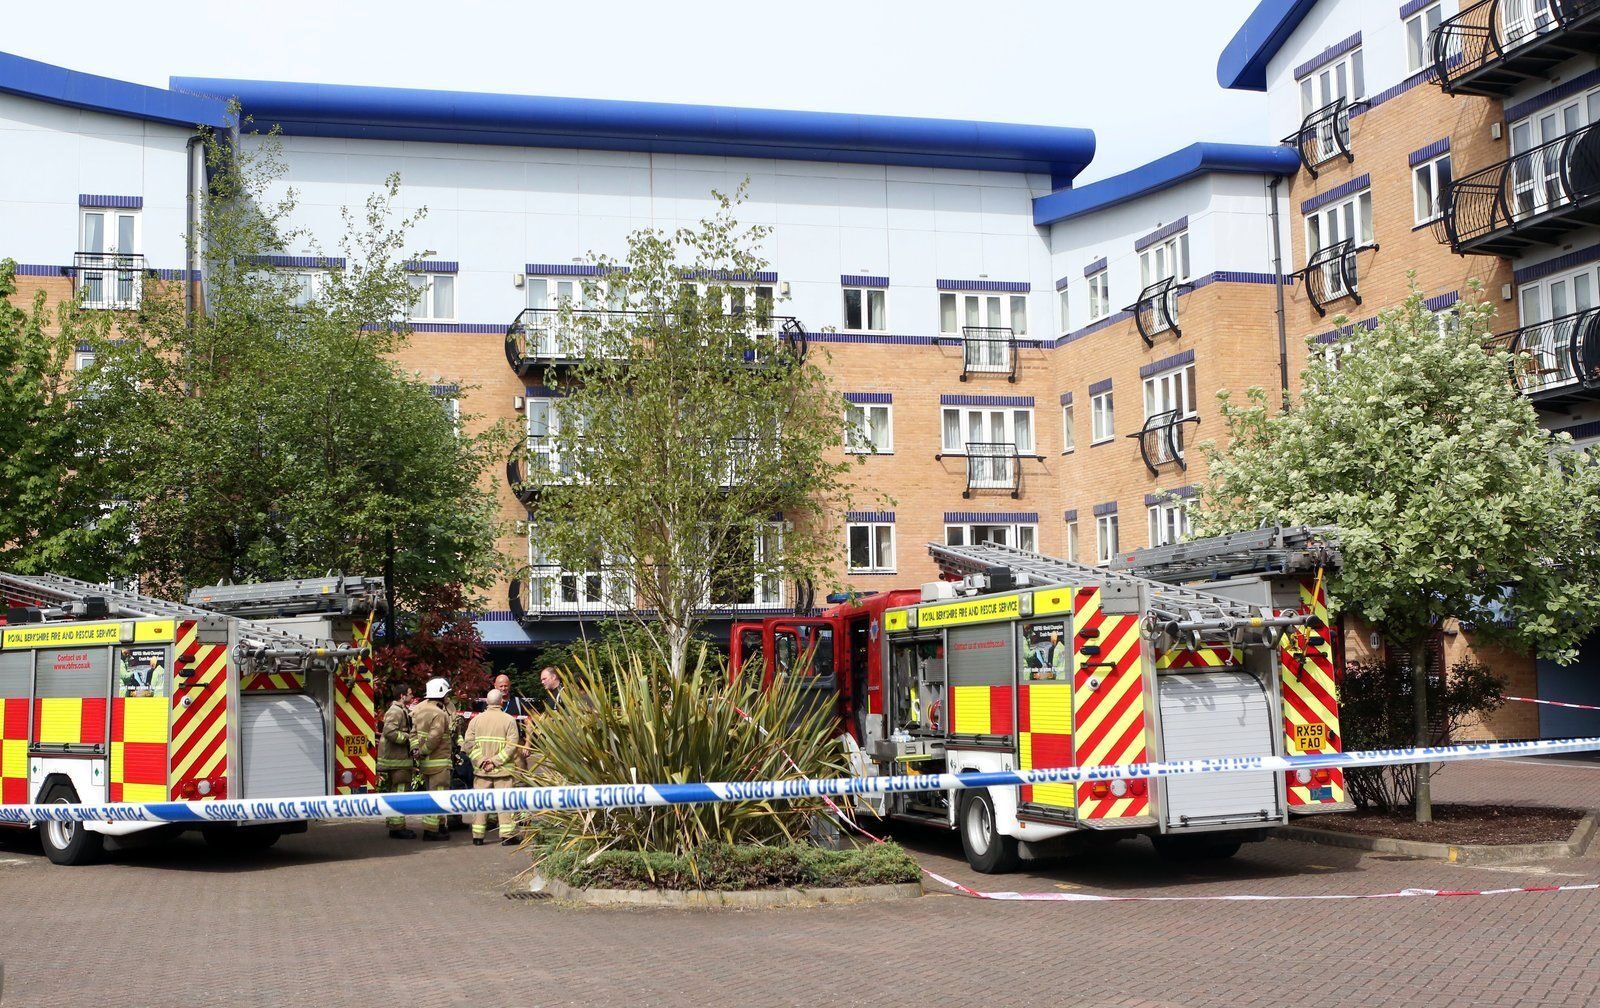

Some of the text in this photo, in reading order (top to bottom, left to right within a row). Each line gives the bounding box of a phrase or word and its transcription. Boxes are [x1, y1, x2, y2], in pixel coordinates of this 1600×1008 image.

[922, 601, 1017, 621] ROYAL BERKSHIRE FIRE AND RESCUE SERVICE
[8, 628, 117, 643] ROYAL BERKSHIRE FIRE AND RESCUE SERVICE
[57, 654, 75, 662] Contact
[1296, 725, 1323, 737] RX59
[345, 735, 366, 745] RX59
[1300, 738, 1321, 748] FAO
[347, 745, 363, 755] FBA
[725, 774, 941, 800] POLICE LINE DO NOT CROSS
[449, 786, 647, 813] POLICE LINE DO NOT CROSS
[30, 808, 55, 821] NOT
[55, 807, 74, 821] DO
[73, 807, 100, 821] LINE
[101, 807, 147, 822] POLICE
[205, 798, 382, 820] POLICE LINE DO NOT CROSS
